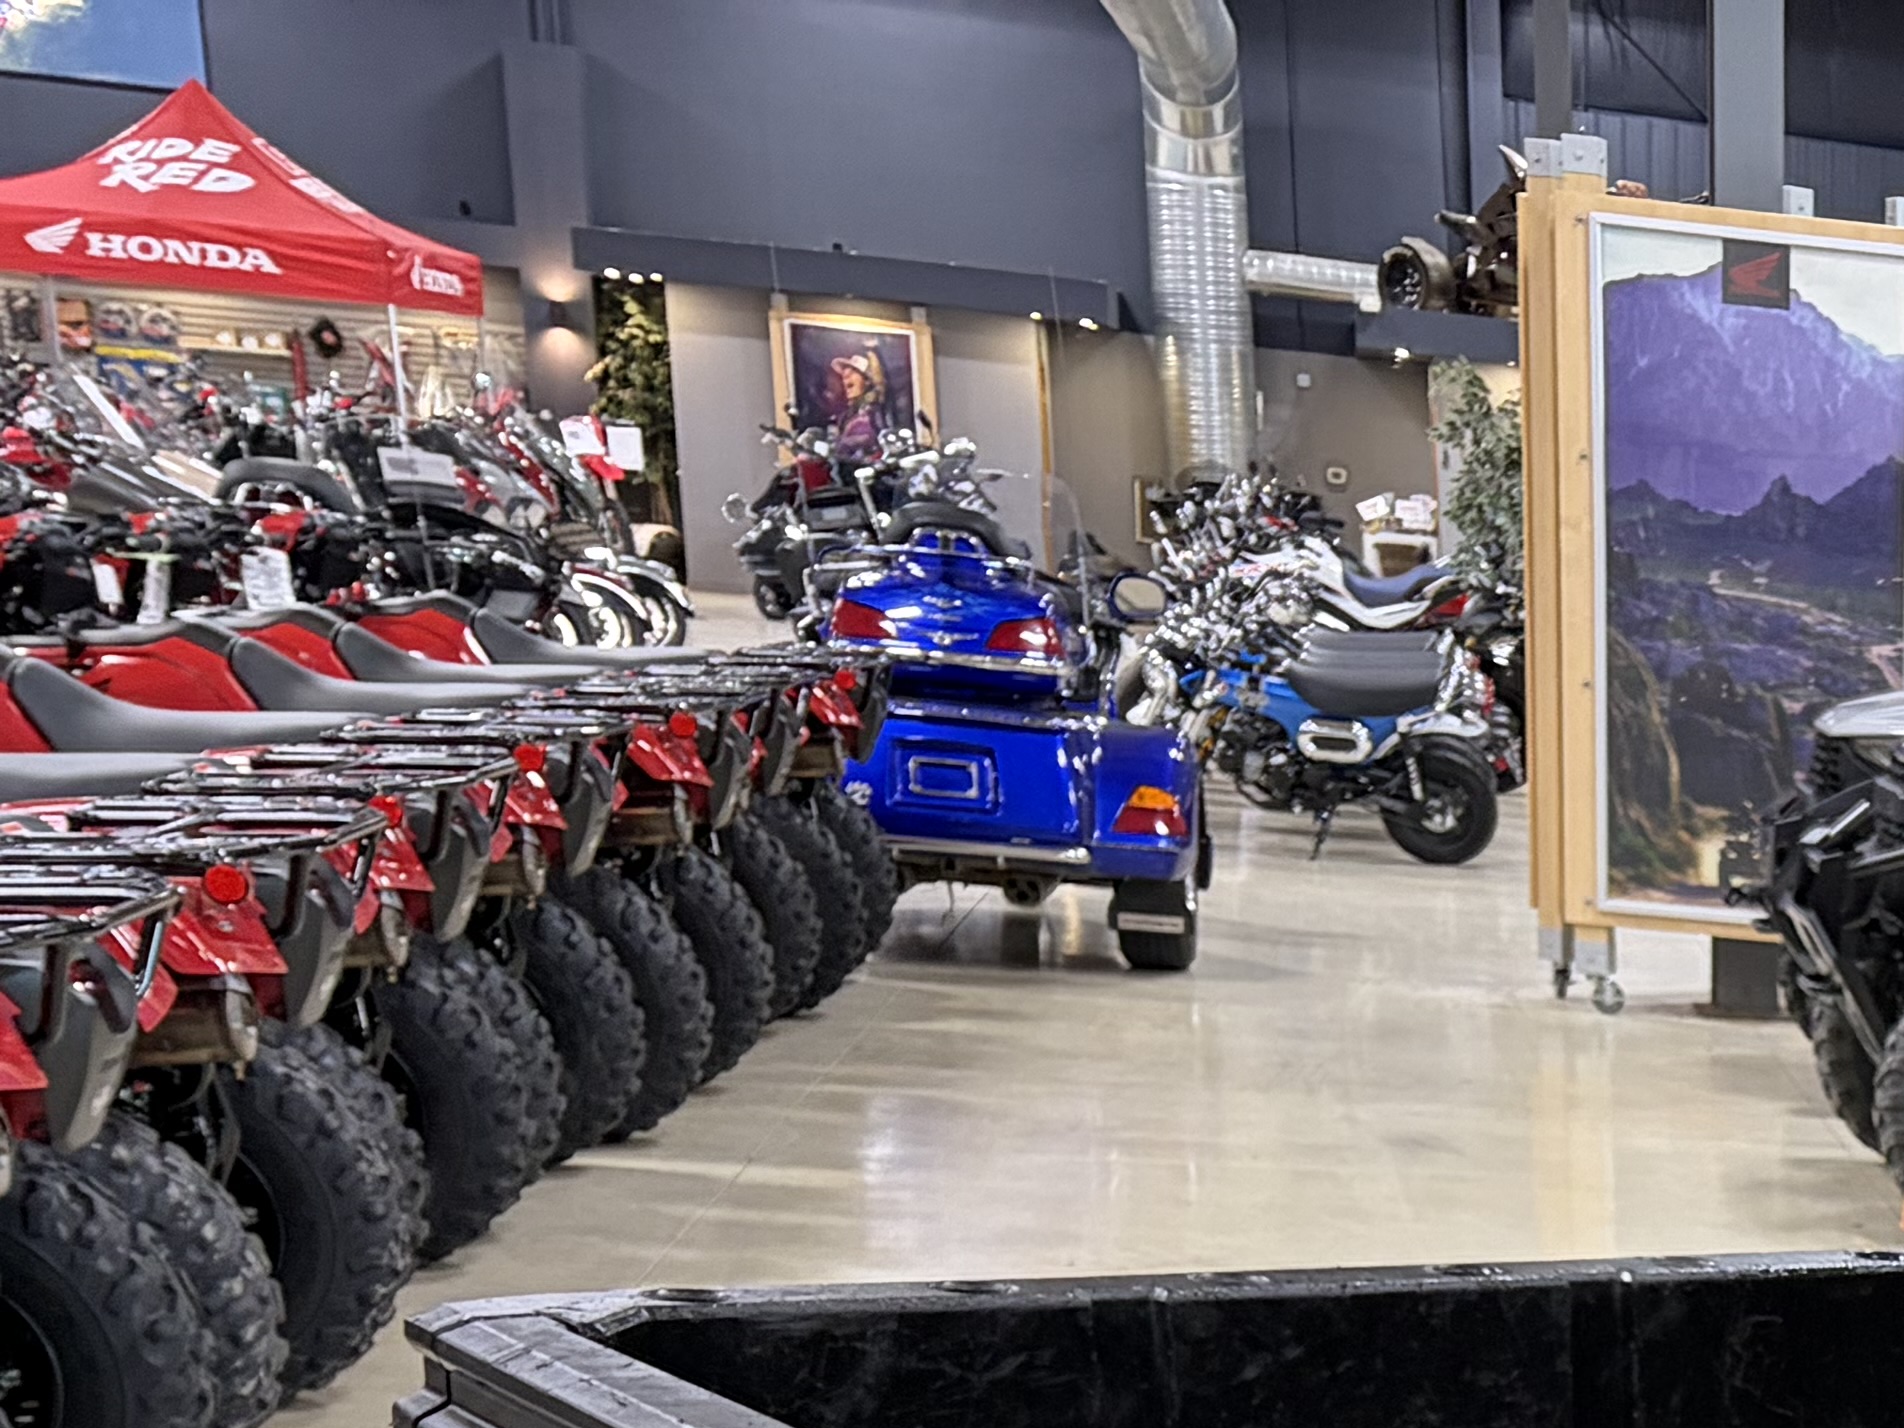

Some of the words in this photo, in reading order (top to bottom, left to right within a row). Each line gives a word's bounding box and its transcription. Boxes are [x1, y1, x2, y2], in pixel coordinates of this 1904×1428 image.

[98, 138, 242, 164] RIDE
[100, 163, 256, 193] RED
[84, 231, 283, 275] HONDA
